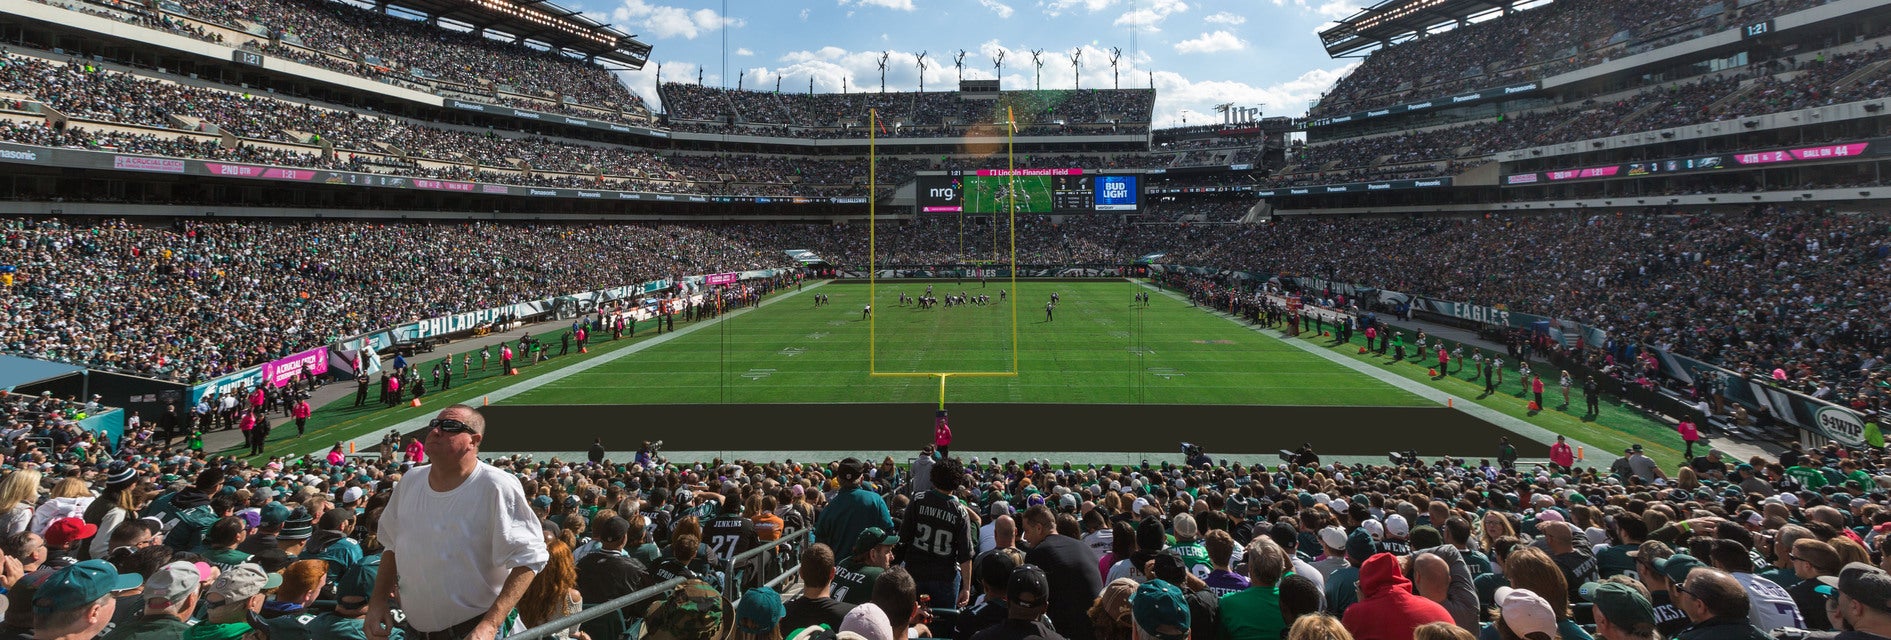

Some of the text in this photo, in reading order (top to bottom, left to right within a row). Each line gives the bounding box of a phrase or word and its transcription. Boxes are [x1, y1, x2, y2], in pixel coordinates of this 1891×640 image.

[1746, 22, 1768, 36] 1:21
[243, 53, 260, 65] 1:21
[1505, 83, 1537, 94] Panasonic
[1453, 93, 1481, 102] Panasonic
[454, 101, 484, 111] Panasonic
[514, 110, 539, 119] Panasonic
[1775, 151, 1782, 161] 2
[1834, 146, 1848, 156] 44
[221, 165, 239, 175] 2ND
[1022, 168, 1051, 176] Financial
[1652, 163, 1658, 171] 3
[282, 170, 296, 179] 1:21
[1105, 182, 1126, 190] BUD
[1103, 190, 1128, 199] LIGHT
[966, 269, 996, 278] EALES
[281, 359, 301, 374] CRUCIAL
[919, 505, 958, 525] DAWKINS
[713, 520, 742, 528] JENKINS
[913, 522, 954, 556] 20
[711, 535, 740, 561] 27
[834, 566, 866, 584] WENTZ
